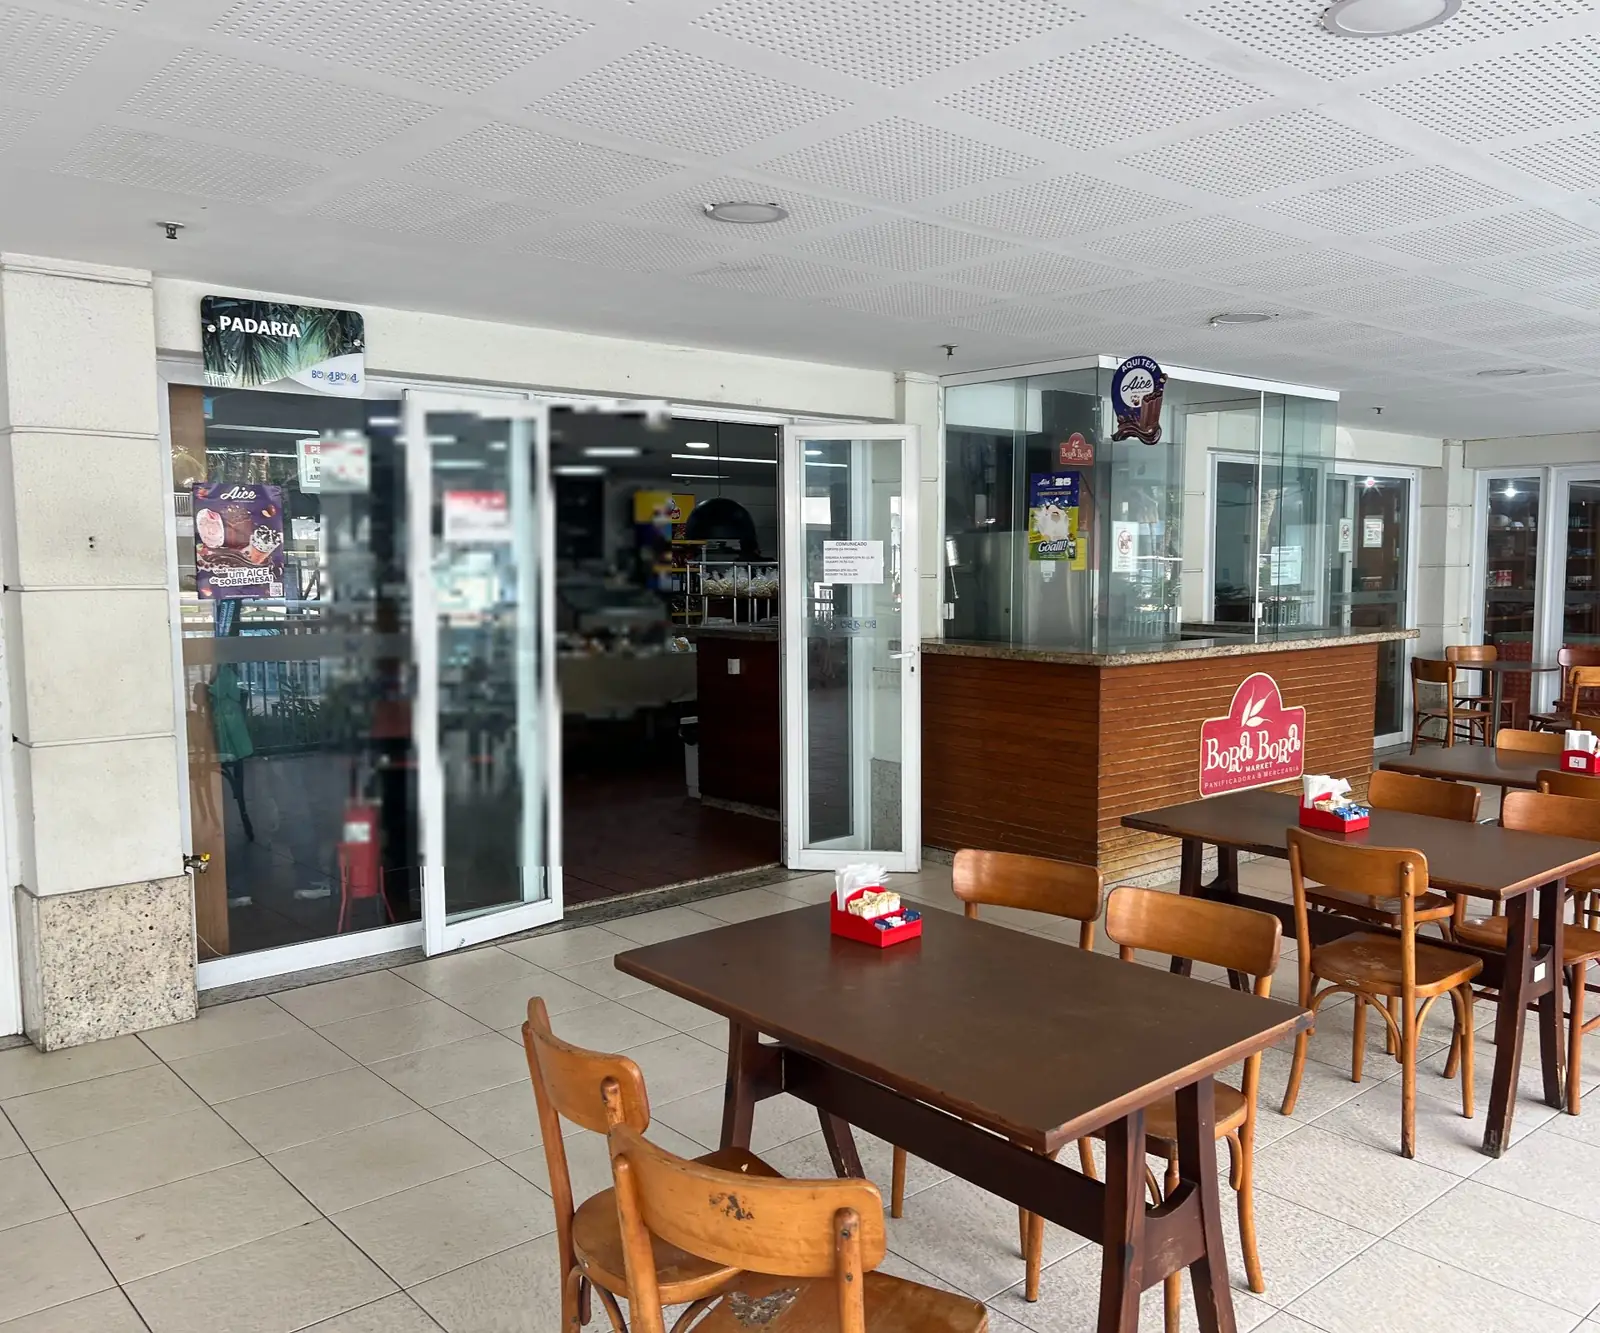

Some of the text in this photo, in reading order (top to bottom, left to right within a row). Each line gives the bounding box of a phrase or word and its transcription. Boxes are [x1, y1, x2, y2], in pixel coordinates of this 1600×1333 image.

[219, 315, 301, 338] PADARIA
[1121, 358, 1157, 372] AQUI TEM
[1122, 375, 1152, 392] Aice
[220, 486, 257, 500] Aice
[247, 568, 268, 577] AICE
[219, 576, 273, 585] SOBREMESA!
[1245, 761, 1273, 772] MARKET
[1204, 775, 1256, 788] PANIFICADORA
[1263, 765, 1300, 777] MERCEARIA
